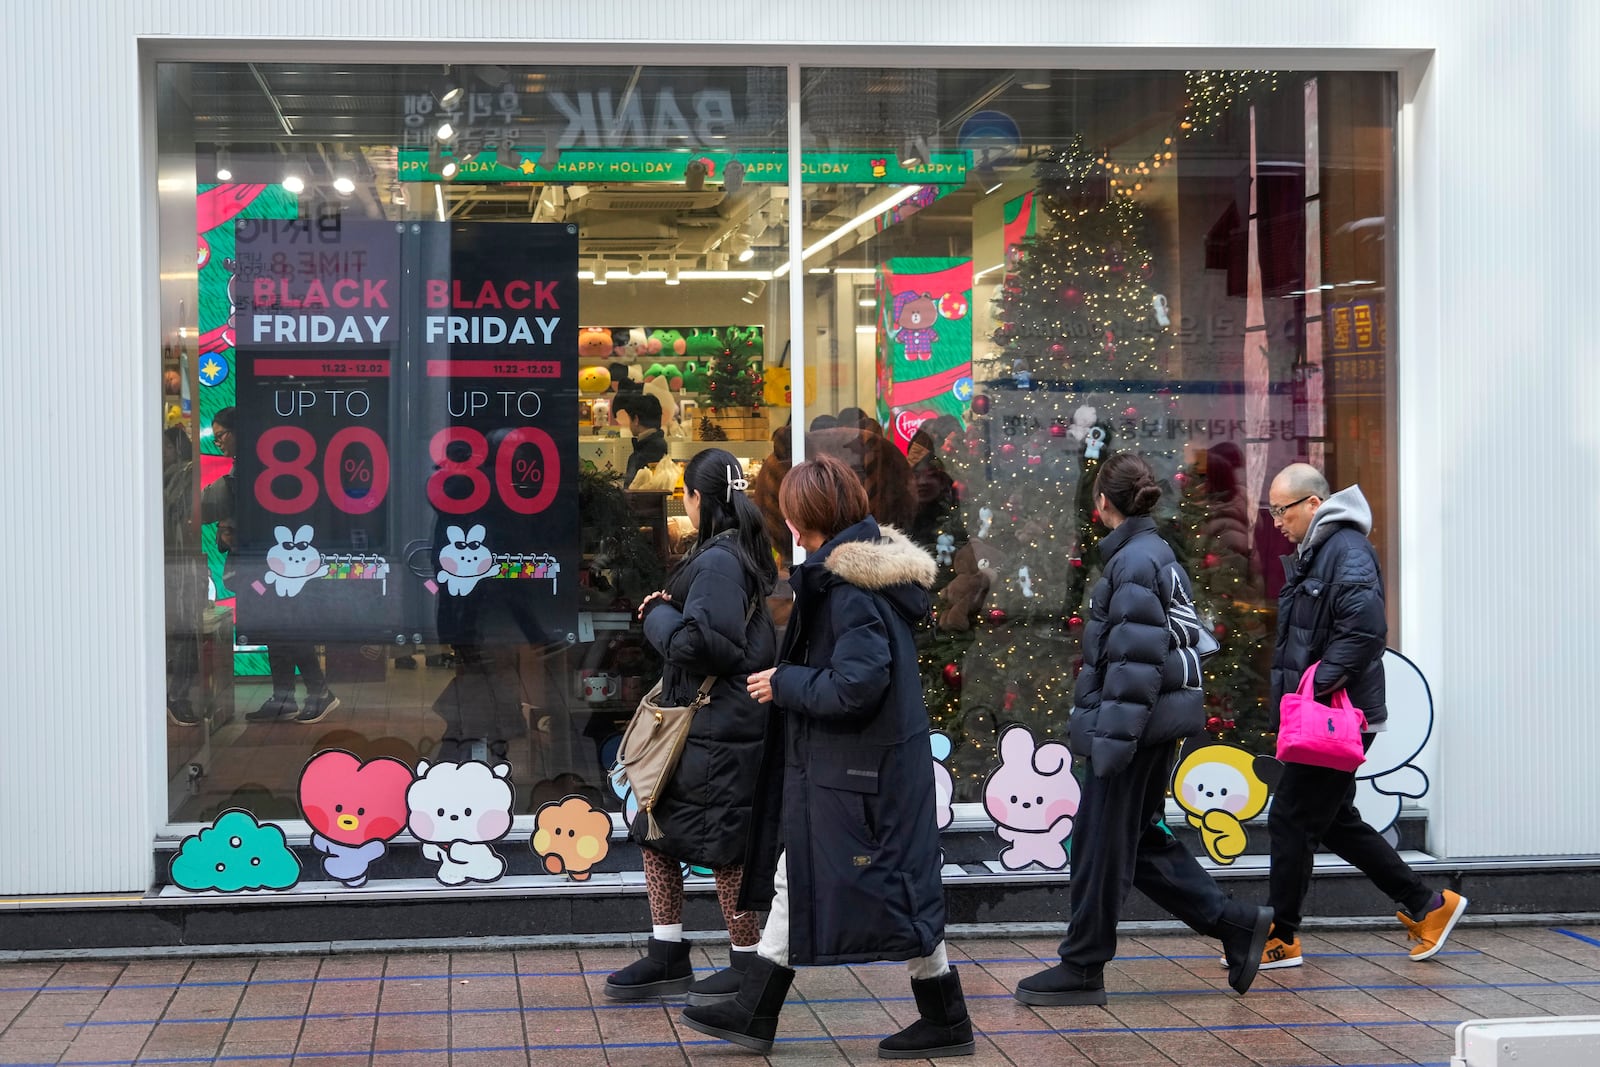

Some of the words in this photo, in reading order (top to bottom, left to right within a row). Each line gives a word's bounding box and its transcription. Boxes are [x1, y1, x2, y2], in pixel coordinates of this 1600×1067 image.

[557, 162, 604, 173] HAPPY
[609, 162, 672, 173] HOLIDAY
[743, 163, 783, 173] APPY
[253, 279, 389, 309] BLACK
[427, 280, 560, 310] BLACK
[253, 315, 389, 343] FRIDAY
[426, 316, 560, 344] FRIDAY
[275, 391, 316, 417] UP
[324, 391, 370, 417] TO
[448, 391, 488, 417] UP
[496, 391, 542, 417] TO
